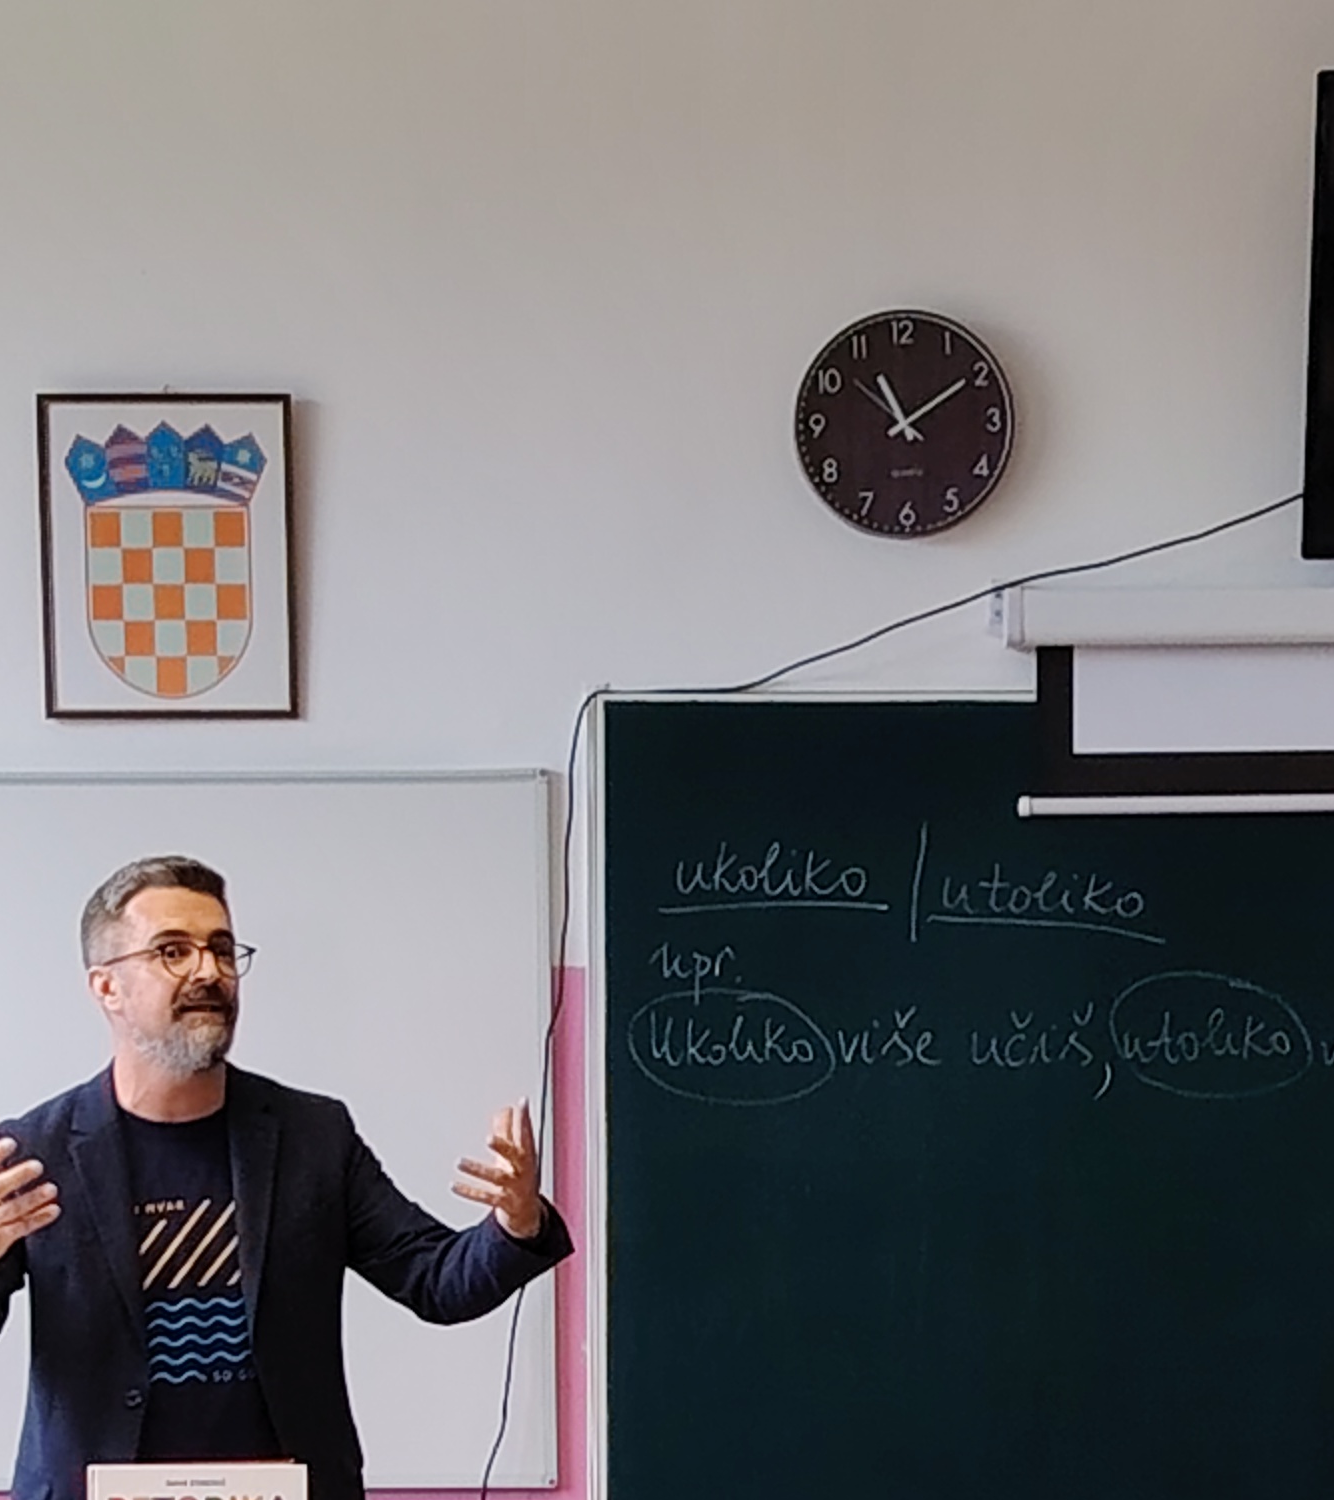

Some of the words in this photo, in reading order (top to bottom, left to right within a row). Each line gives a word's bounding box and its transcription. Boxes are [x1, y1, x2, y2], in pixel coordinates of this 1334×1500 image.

[891, 319, 914, 345] 12
[944, 331, 952, 355] 1
[852, 334, 866, 359] 11
[818, 367, 842, 394] 10
[973, 361, 990, 387] 2
[808, 413, 825, 438] 9
[986, 407, 1001, 432] 3
[822, 458, 838, 482] 8
[972, 454, 990, 477] 4
[859, 491, 874, 517] 7
[943, 488, 959, 512] 5
[899, 501, 915, 526] 6
[676, 842, 867, 897] ukoliko
[942, 862, 1145, 918] utoliko
[838, 1005, 942, 1066] više
[1123, 1007, 1292, 1065] utoliko
